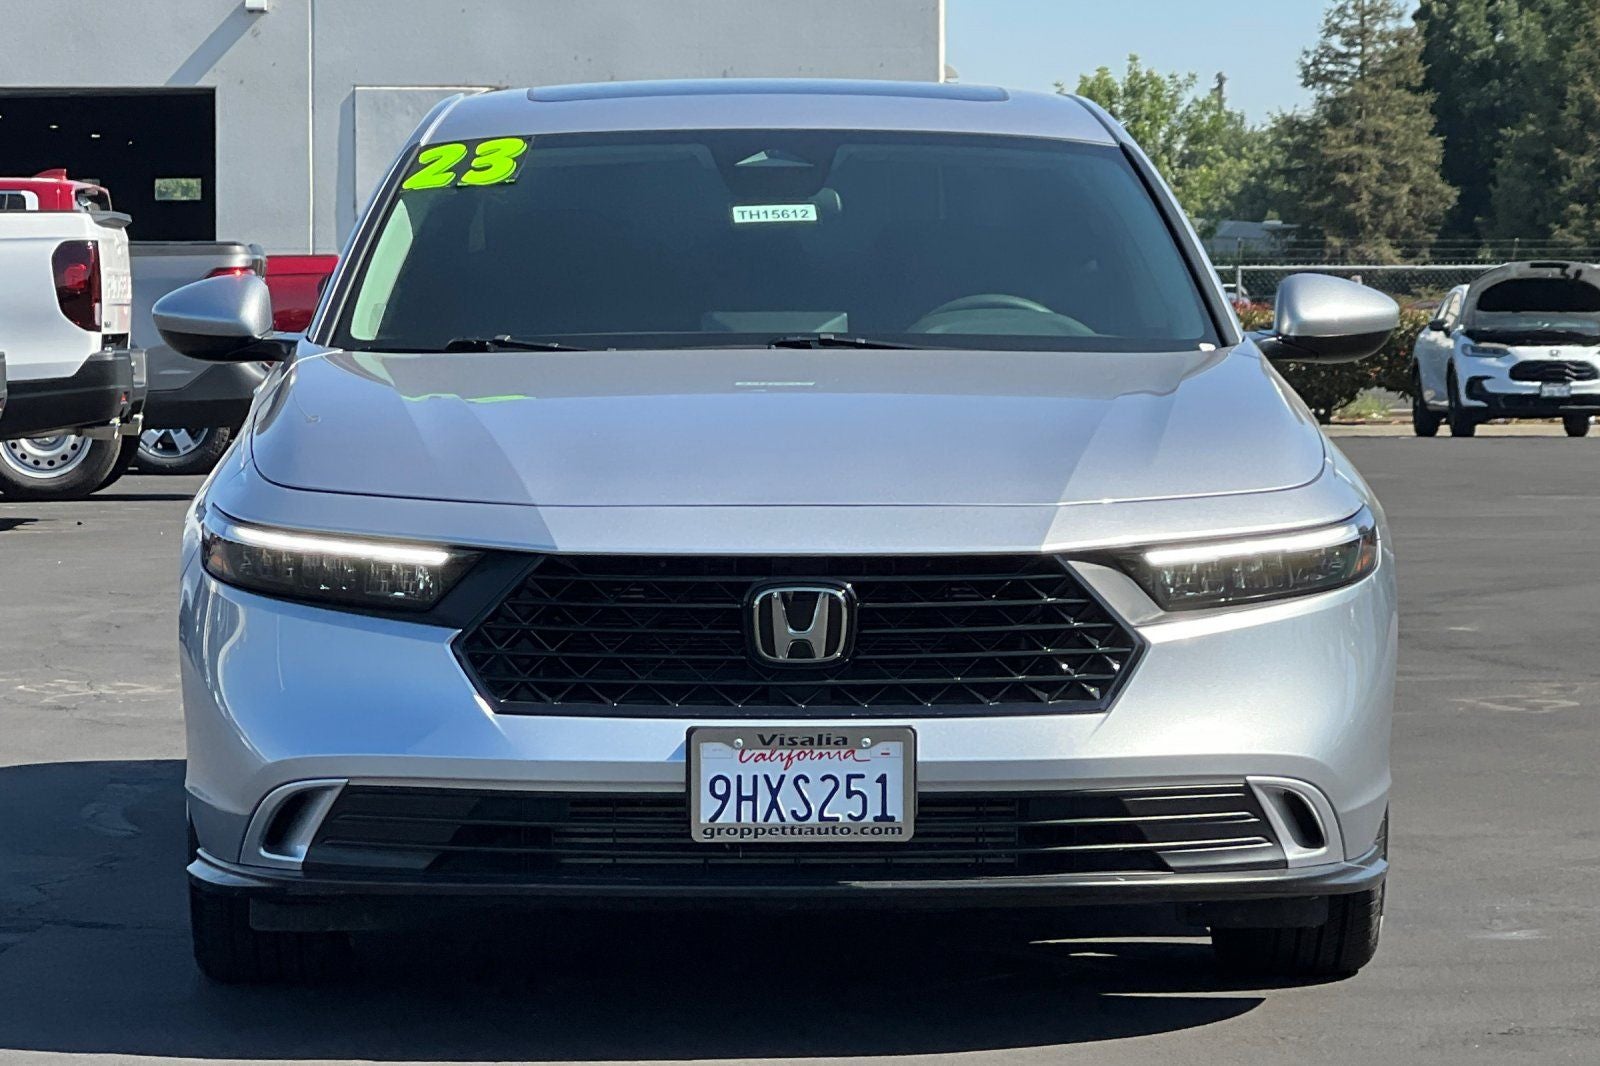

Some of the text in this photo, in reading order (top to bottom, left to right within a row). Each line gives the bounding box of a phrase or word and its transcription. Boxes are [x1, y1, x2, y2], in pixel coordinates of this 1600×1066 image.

[402, 137, 528, 190] 23
[738, 208, 809, 221] TH15612
[757, 733, 848, 747] Visalia
[738, 748, 871, 771] California
[708, 773, 896, 823] 9HXS251
[702, 823, 904, 840] groppettiauto.com
